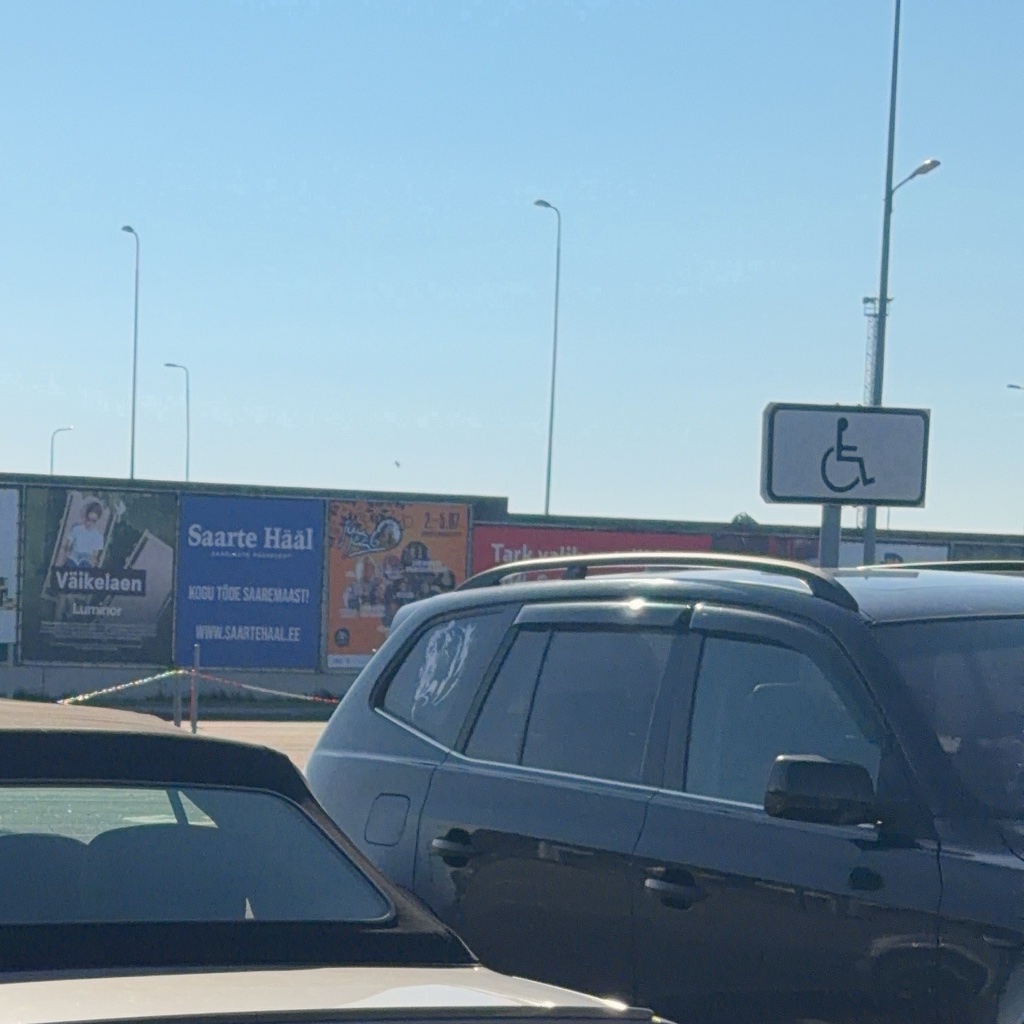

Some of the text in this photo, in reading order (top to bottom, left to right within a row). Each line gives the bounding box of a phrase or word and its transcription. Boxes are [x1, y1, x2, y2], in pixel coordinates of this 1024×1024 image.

[188, 523, 314, 550] Saarte Hääl
[490, 543, 533, 563] Tark
[55, 570, 143, 593] Väikelaen
[187, 585, 215, 601] KOGU
[242, 586, 310, 604] SAAREMAAST!
[72, 602, 123, 617] Luminor
[195, 624, 301, 642] WWW.SAARTEHAAL.EE
